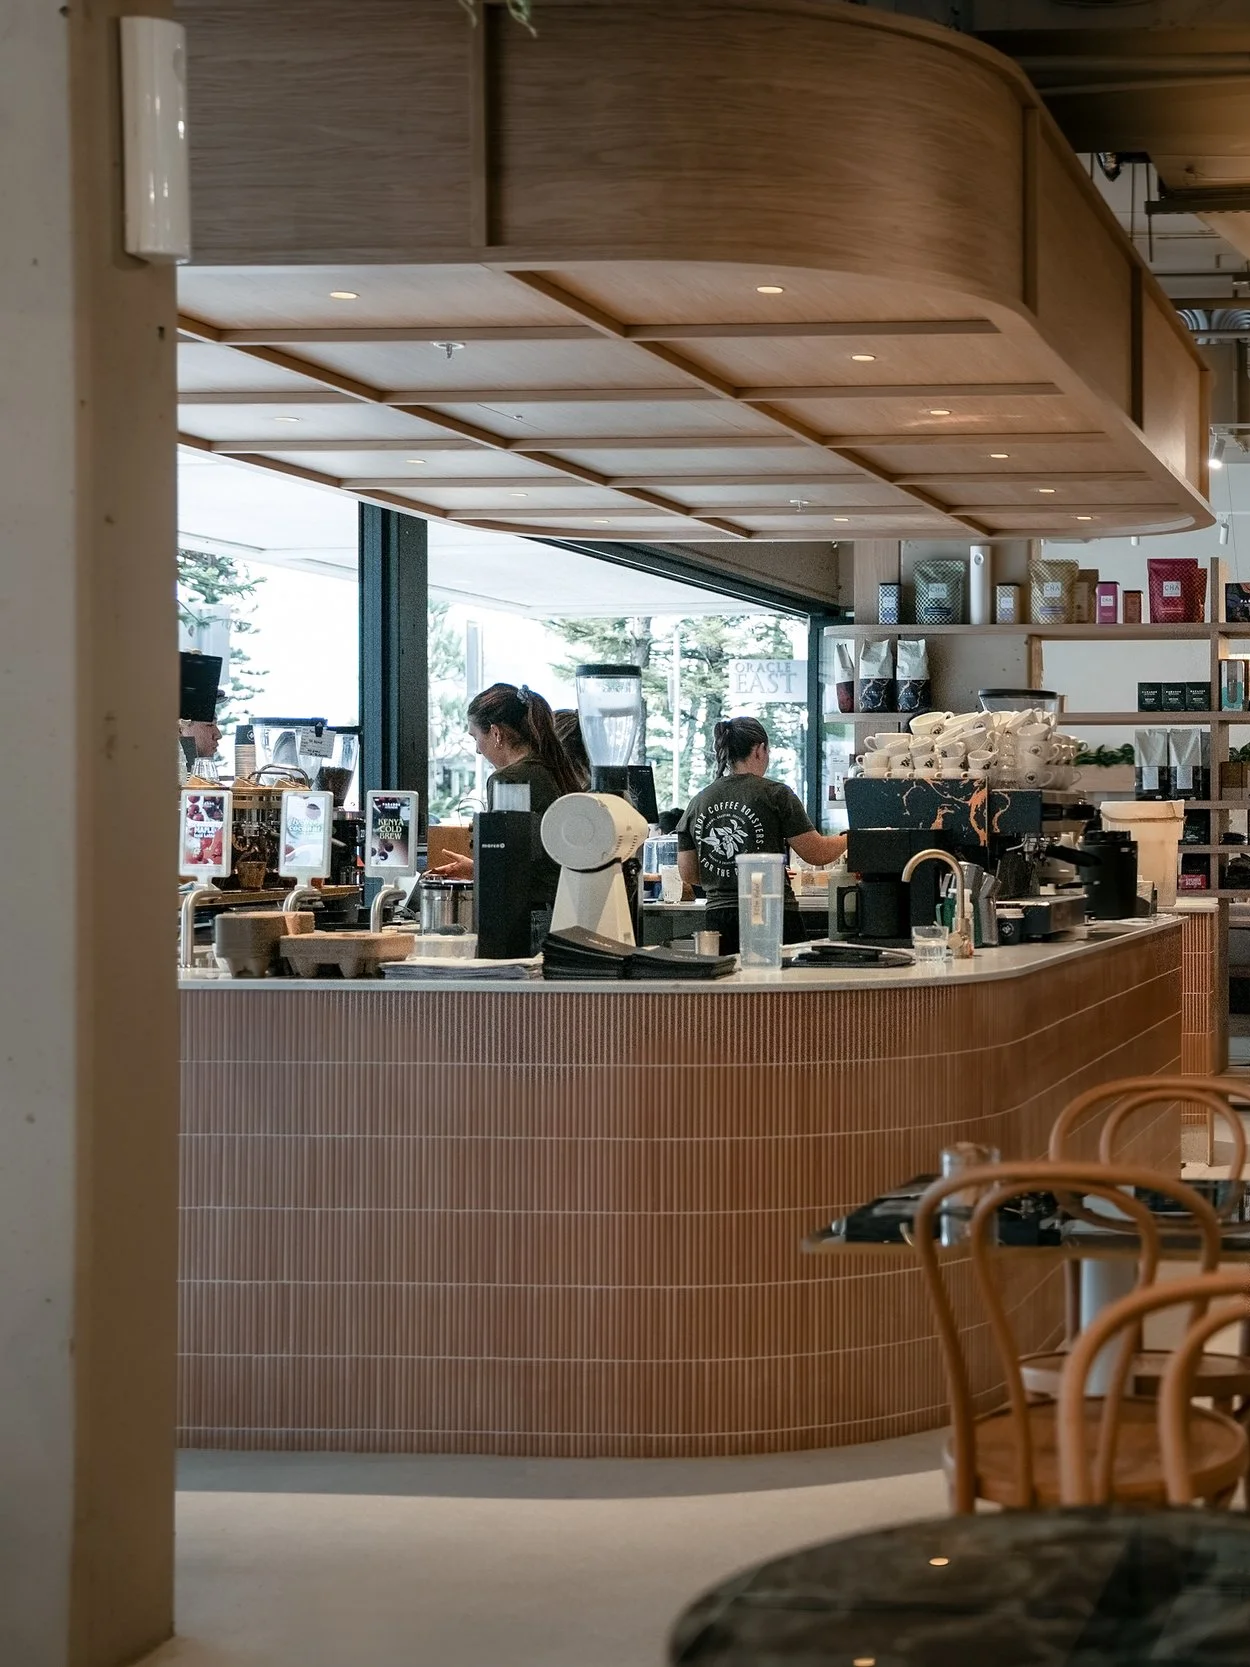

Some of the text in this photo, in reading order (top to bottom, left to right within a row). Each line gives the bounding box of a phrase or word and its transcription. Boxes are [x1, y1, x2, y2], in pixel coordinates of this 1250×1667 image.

[735, 662, 792, 673] ORACLE
[734, 672, 797, 694] EAST
[378, 818, 404, 826] KENYA
[707, 801, 739, 814] COFFEE
[740, 804, 764, 845] ROASTERS
[379, 825, 402, 833] COLD
[379, 832, 402, 840] BREW
[700, 857, 714, 872] FOR
[717, 867, 730, 877] THE
